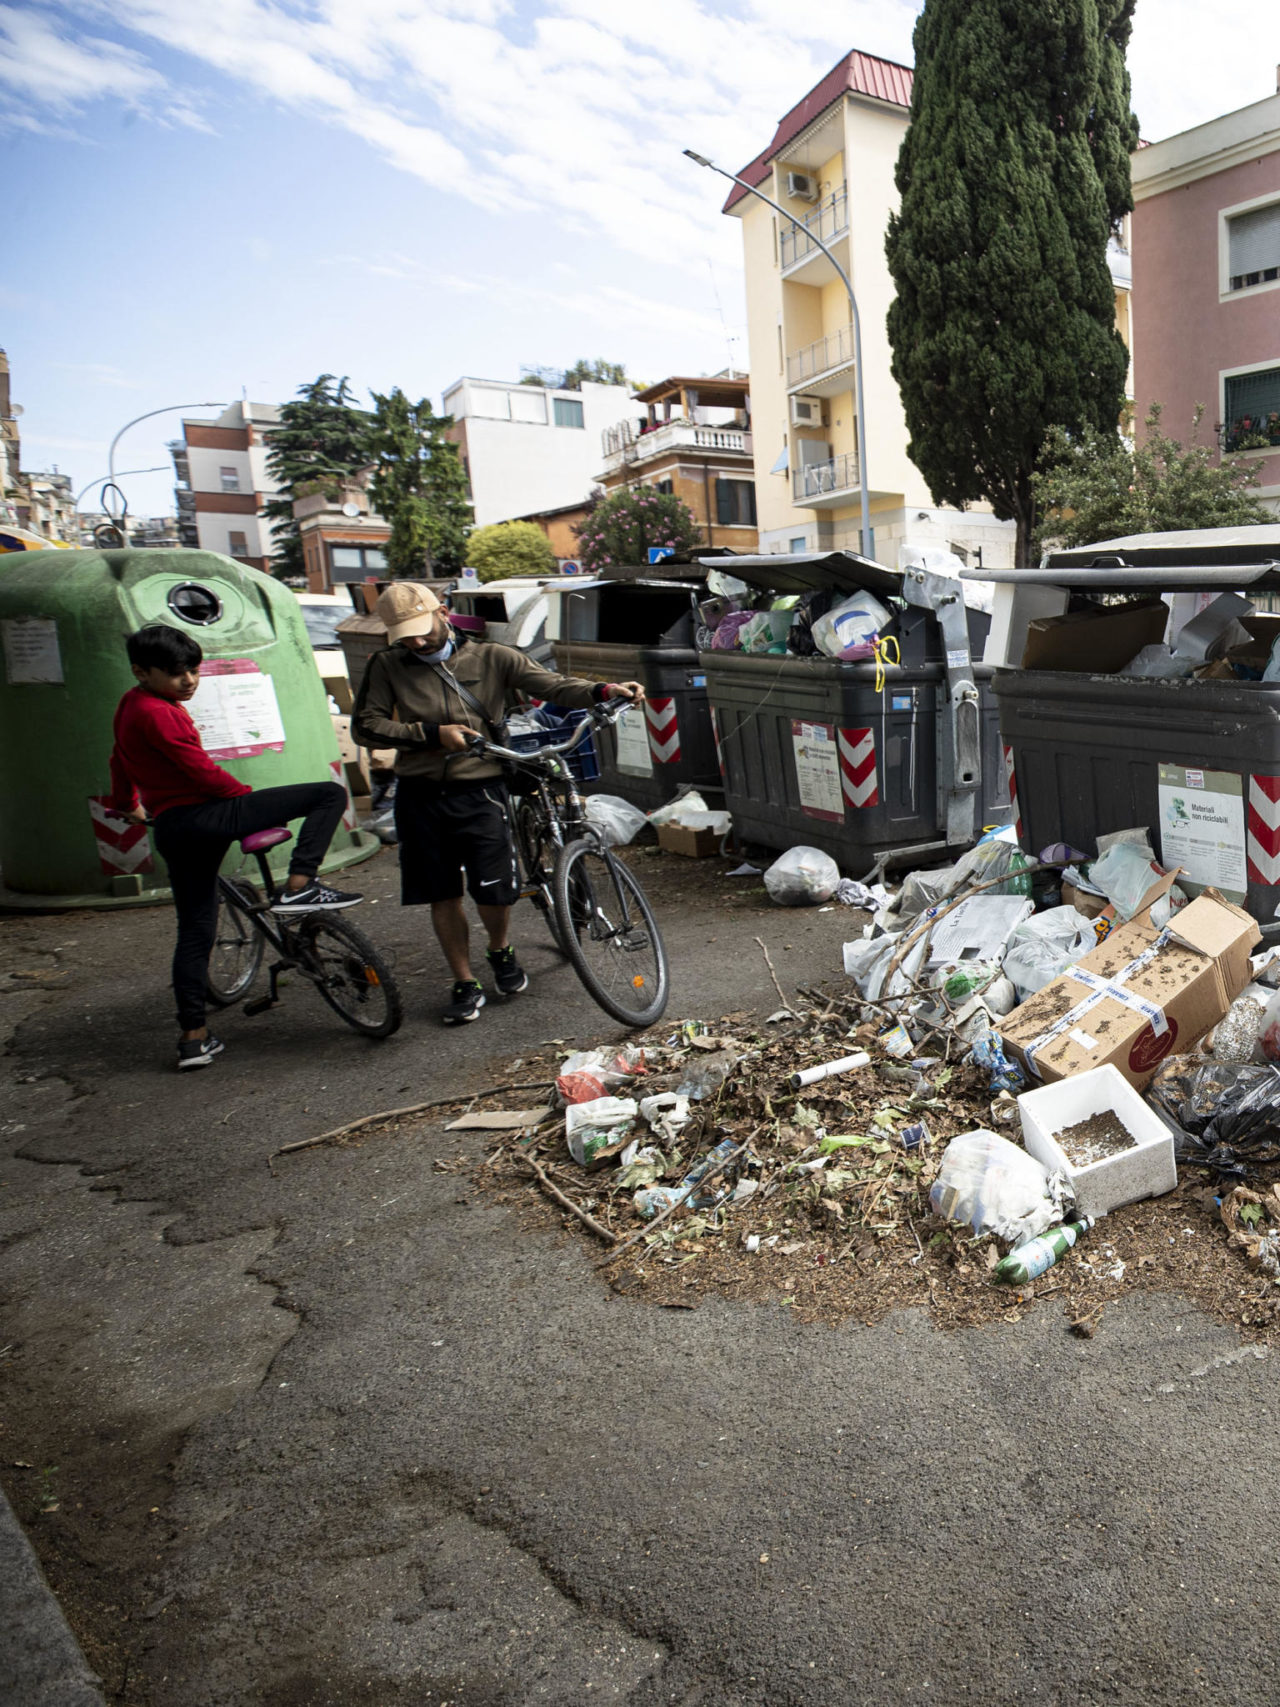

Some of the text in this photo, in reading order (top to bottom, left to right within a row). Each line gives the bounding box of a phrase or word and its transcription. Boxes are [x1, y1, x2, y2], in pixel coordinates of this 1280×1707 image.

[1191, 803, 1215, 814] Materiali
[1191, 813, 1229, 825] non riciclabili
